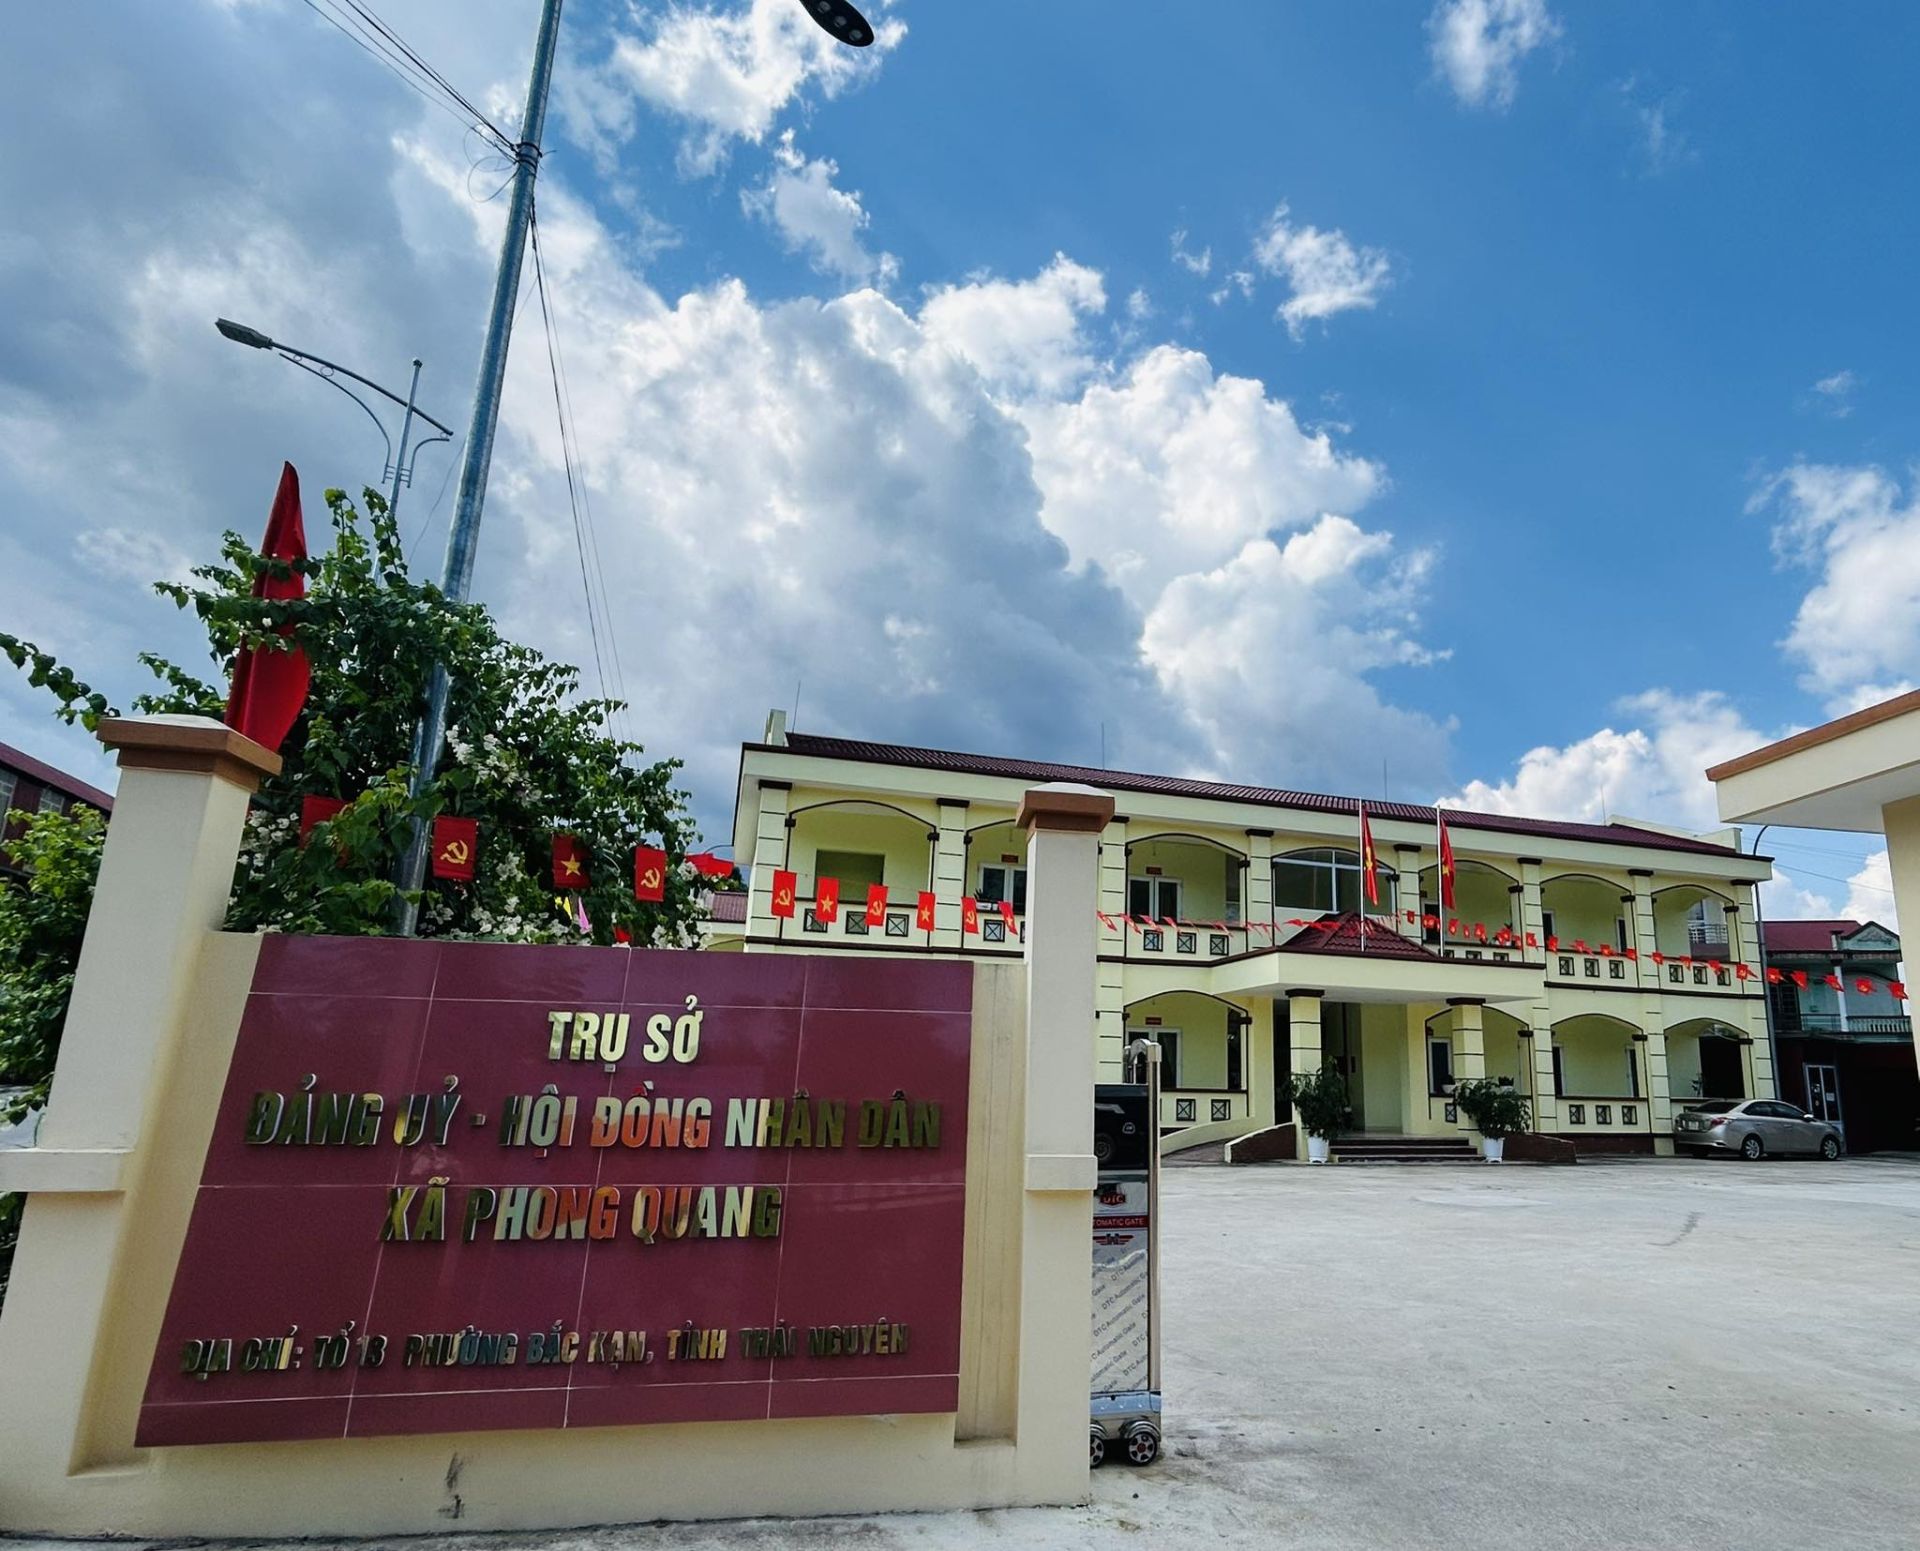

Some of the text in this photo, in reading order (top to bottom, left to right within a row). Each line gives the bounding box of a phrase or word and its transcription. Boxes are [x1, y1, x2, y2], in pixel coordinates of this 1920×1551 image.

[548, 994, 704, 1073] TRỤ SỞ
[246, 1073, 940, 1158] ĐẢNG UỶ - HỘI ĐỒNG NHÂN DÂN
[378, 1176, 782, 1245] XÃ PHONG QUANG
[1124, 1217, 1144, 1226] GATE
[182, 1338, 233, 1381] ĐỊA
[315, 1319, 355, 1369] TỔ
[356, 1334, 388, 1367] 13
[405, 1325, 518, 1367] PHƯỜNG
[527, 1319, 580, 1366] BẮC
[587, 1330, 654, 1370] KẠN,
[666, 1319, 727, 1361] TỈNH
[738, 1318, 797, 1359] THÁI
[808, 1316, 909, 1356] NGUYÊN
